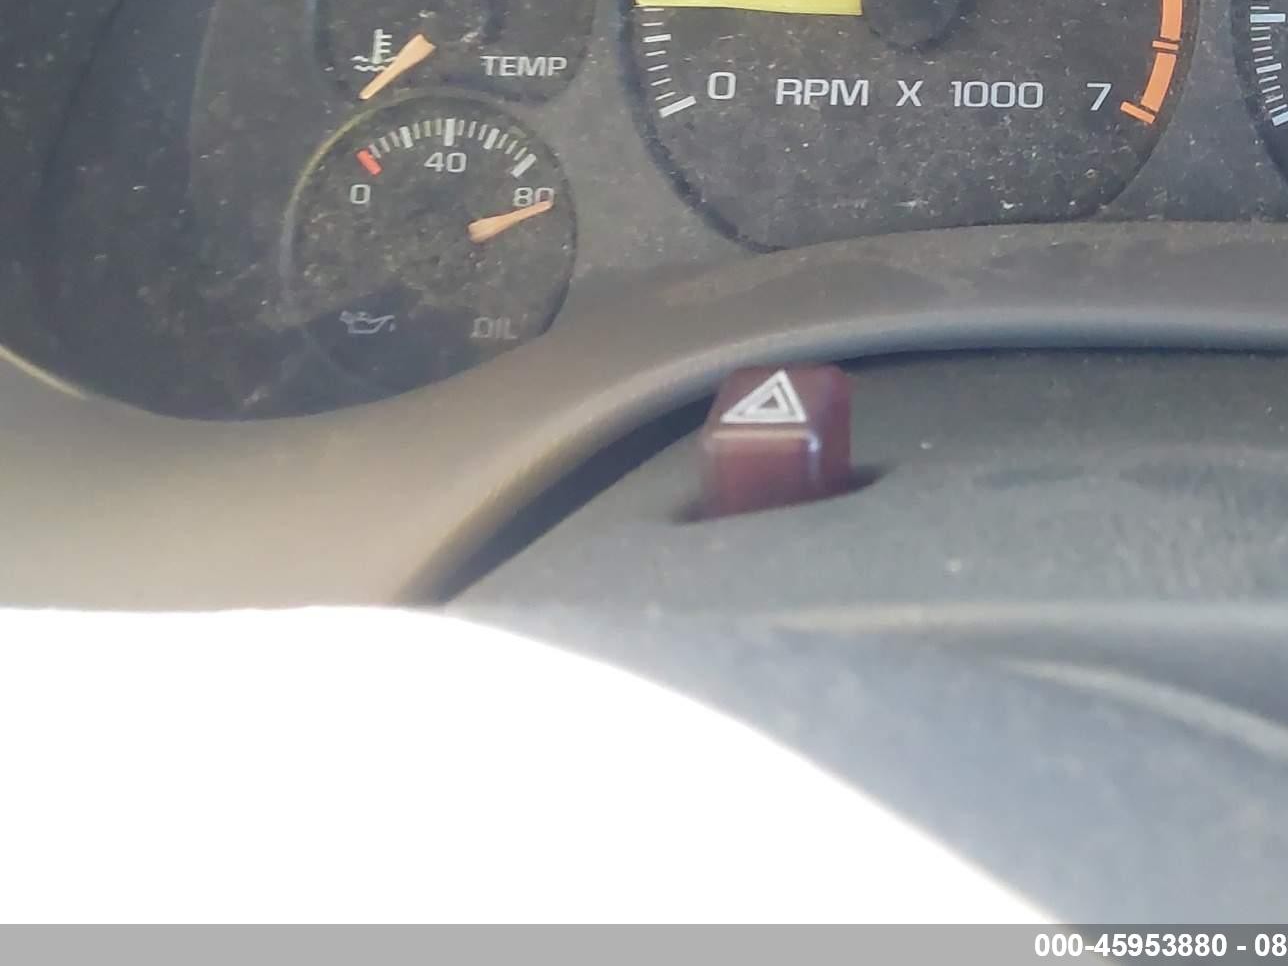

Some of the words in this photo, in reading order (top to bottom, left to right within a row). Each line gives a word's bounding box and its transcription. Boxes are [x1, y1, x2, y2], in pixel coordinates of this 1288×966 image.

[480, 55, 568, 76] TEMP
[708, 71, 736, 100] 0
[775, 78, 869, 107] RPM
[896, 80, 923, 107] X
[951, 80, 1043, 109] 1000
[1086, 82, 1112, 111] 7
[424, 152, 467, 172] 40
[351, 184, 370, 204] 0
[512, 187, 554, 207] 80
